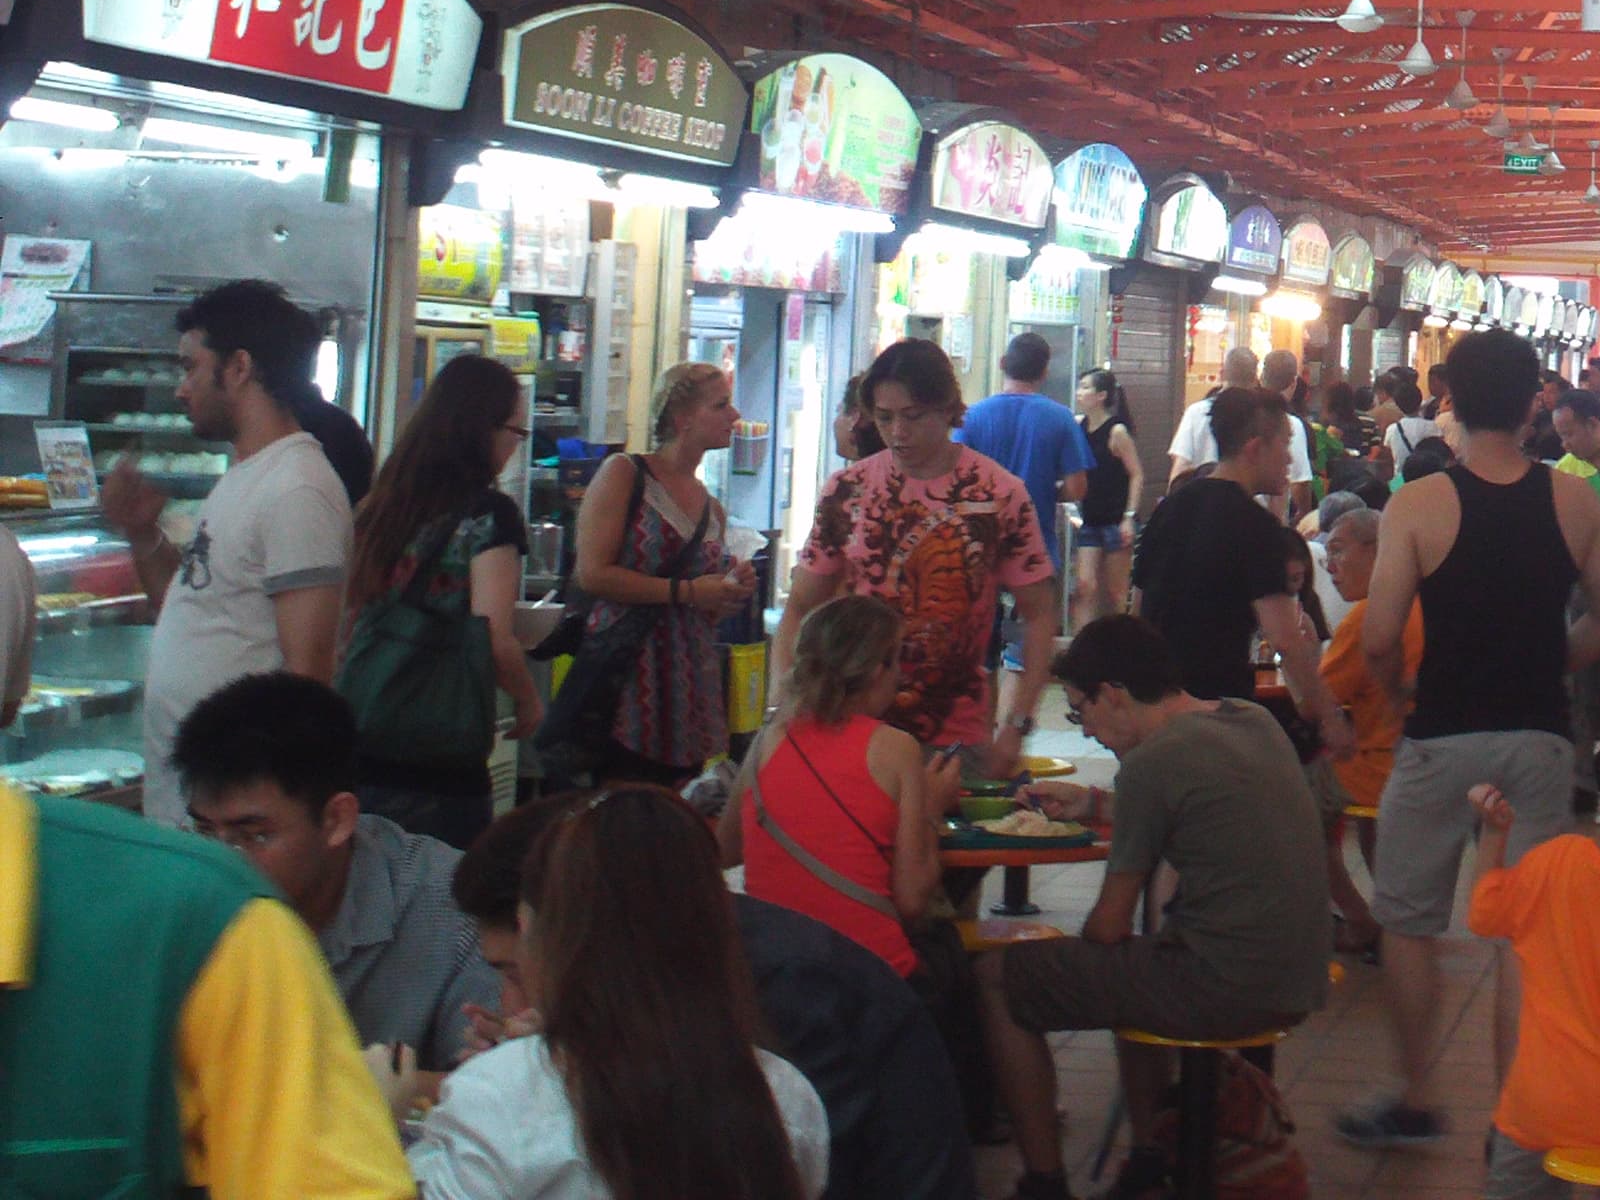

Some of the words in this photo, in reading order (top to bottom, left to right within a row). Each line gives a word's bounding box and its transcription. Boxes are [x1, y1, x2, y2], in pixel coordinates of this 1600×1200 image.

[532, 82, 592, 123] SOON
[617, 102, 682, 142] COFFEE
[682, 116, 727, 151] SHOP
